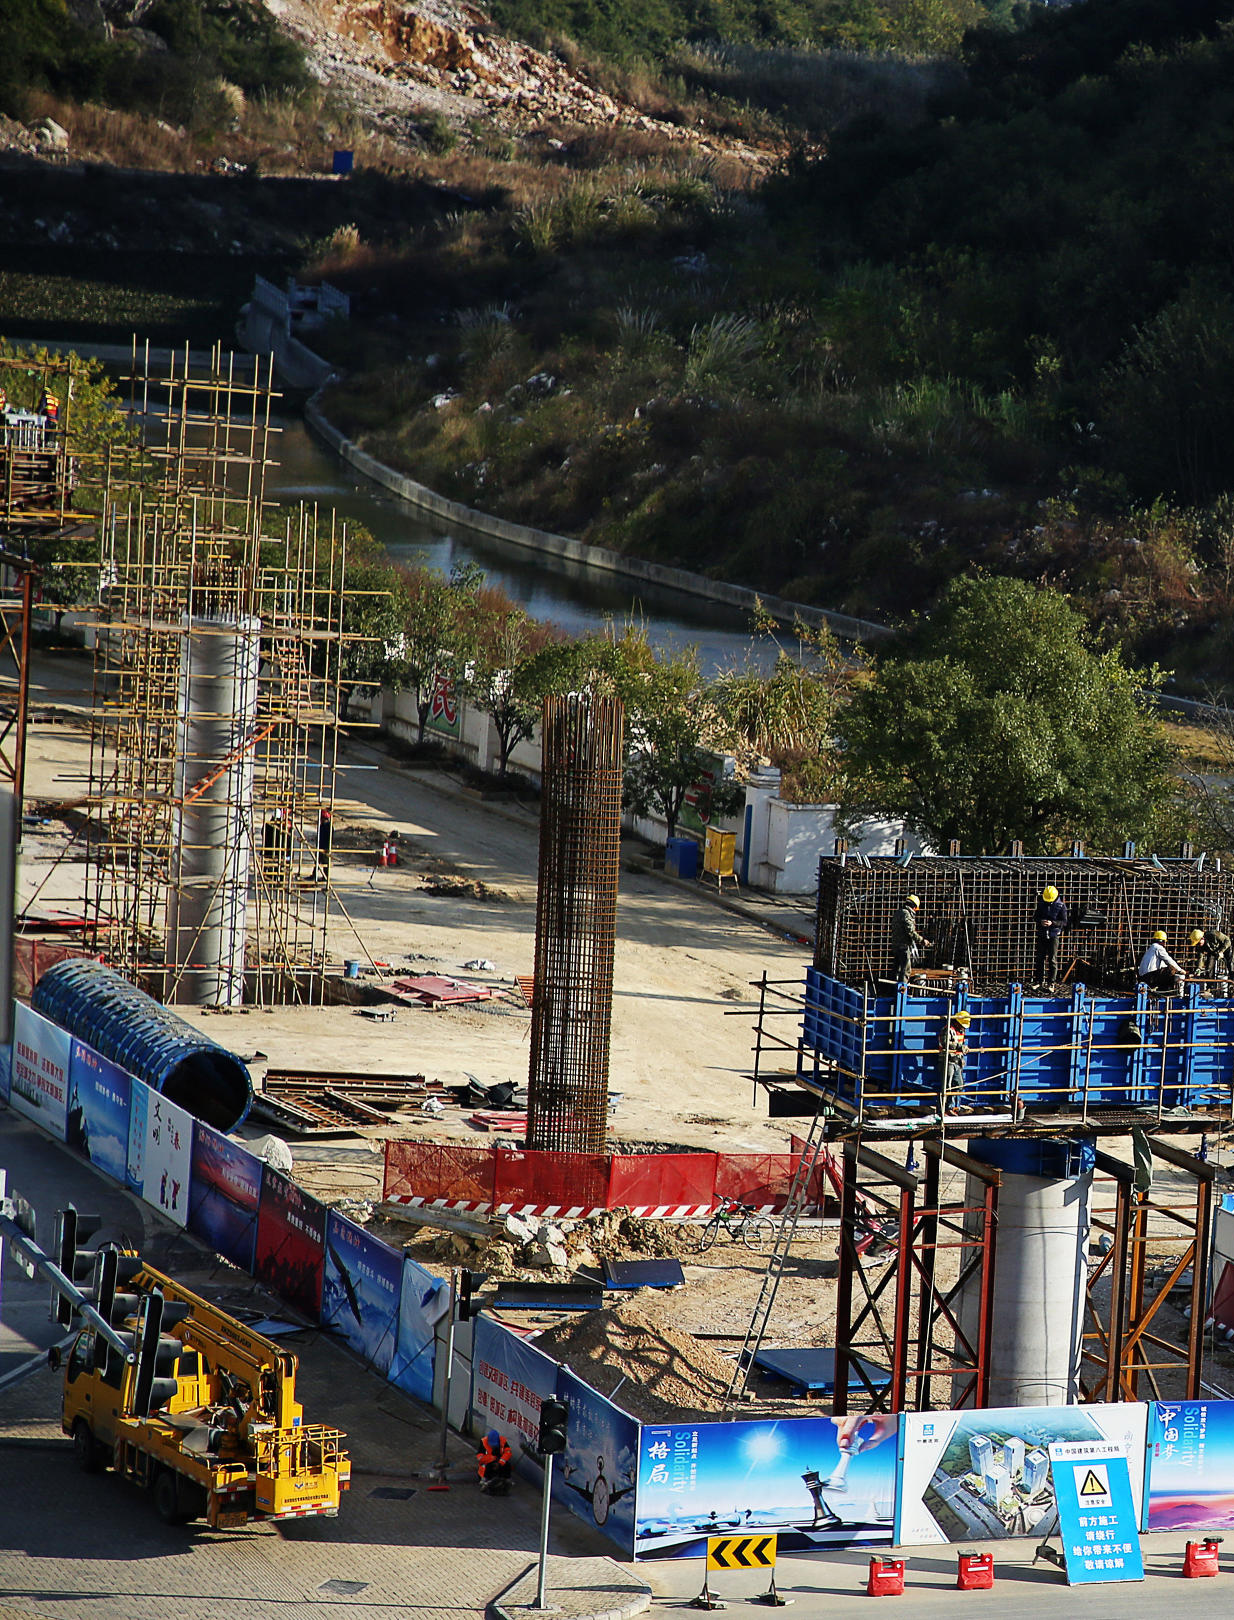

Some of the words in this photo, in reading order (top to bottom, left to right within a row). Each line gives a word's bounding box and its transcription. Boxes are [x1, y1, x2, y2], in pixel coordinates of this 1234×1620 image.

[1159, 1408, 1180, 1461] 中国梦
[1178, 1407, 1200, 1467] Solidarity
[646, 1441, 671, 1485] 格局
[669, 1431, 691, 1493] Solidarity
[1078, 1515, 1119, 1527] 前方施工
[1072, 1543, 1133, 1556] 给你带来不便
[1085, 1530, 1116, 1541] 请绕行
[1084, 1558, 1125, 1570] 敬请谅解
